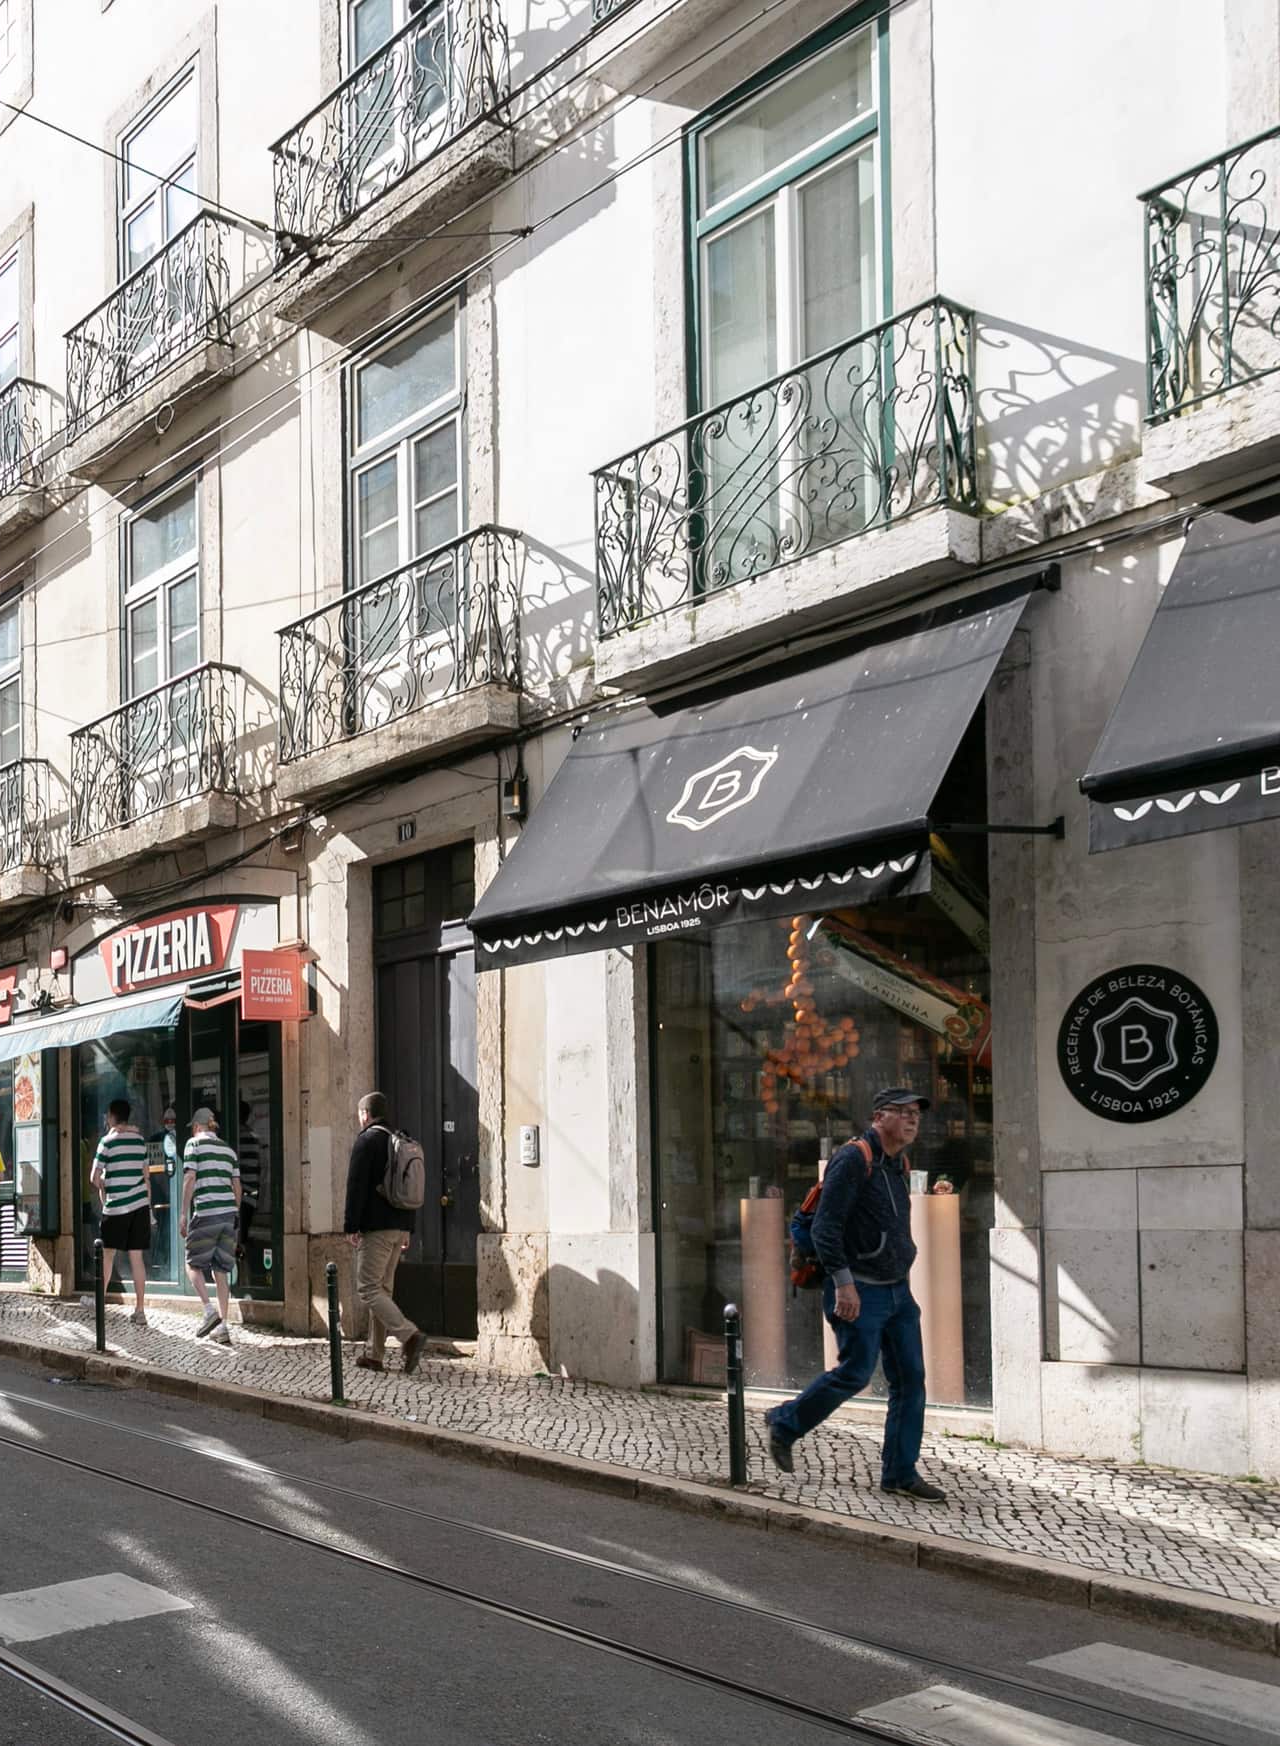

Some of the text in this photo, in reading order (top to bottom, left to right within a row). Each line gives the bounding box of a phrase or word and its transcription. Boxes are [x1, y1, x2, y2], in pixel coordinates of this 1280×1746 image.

[400, 822, 413, 841] 10
[616, 883, 730, 928] BENAMÔR
[646, 917, 702, 936] LISBOA 1925
[111, 911, 214, 987] PIZZERIA
[250, 976, 293, 996] PIZZERIA
[1066, 1006, 1089, 1075] RECEITAS
[1087, 987, 1107, 1006] DE
[1108, 975, 1167, 993] BELEZA
[1120, 1024, 1153, 1065] B
[1090, 1087, 1180, 1113] LISBOA 1925
